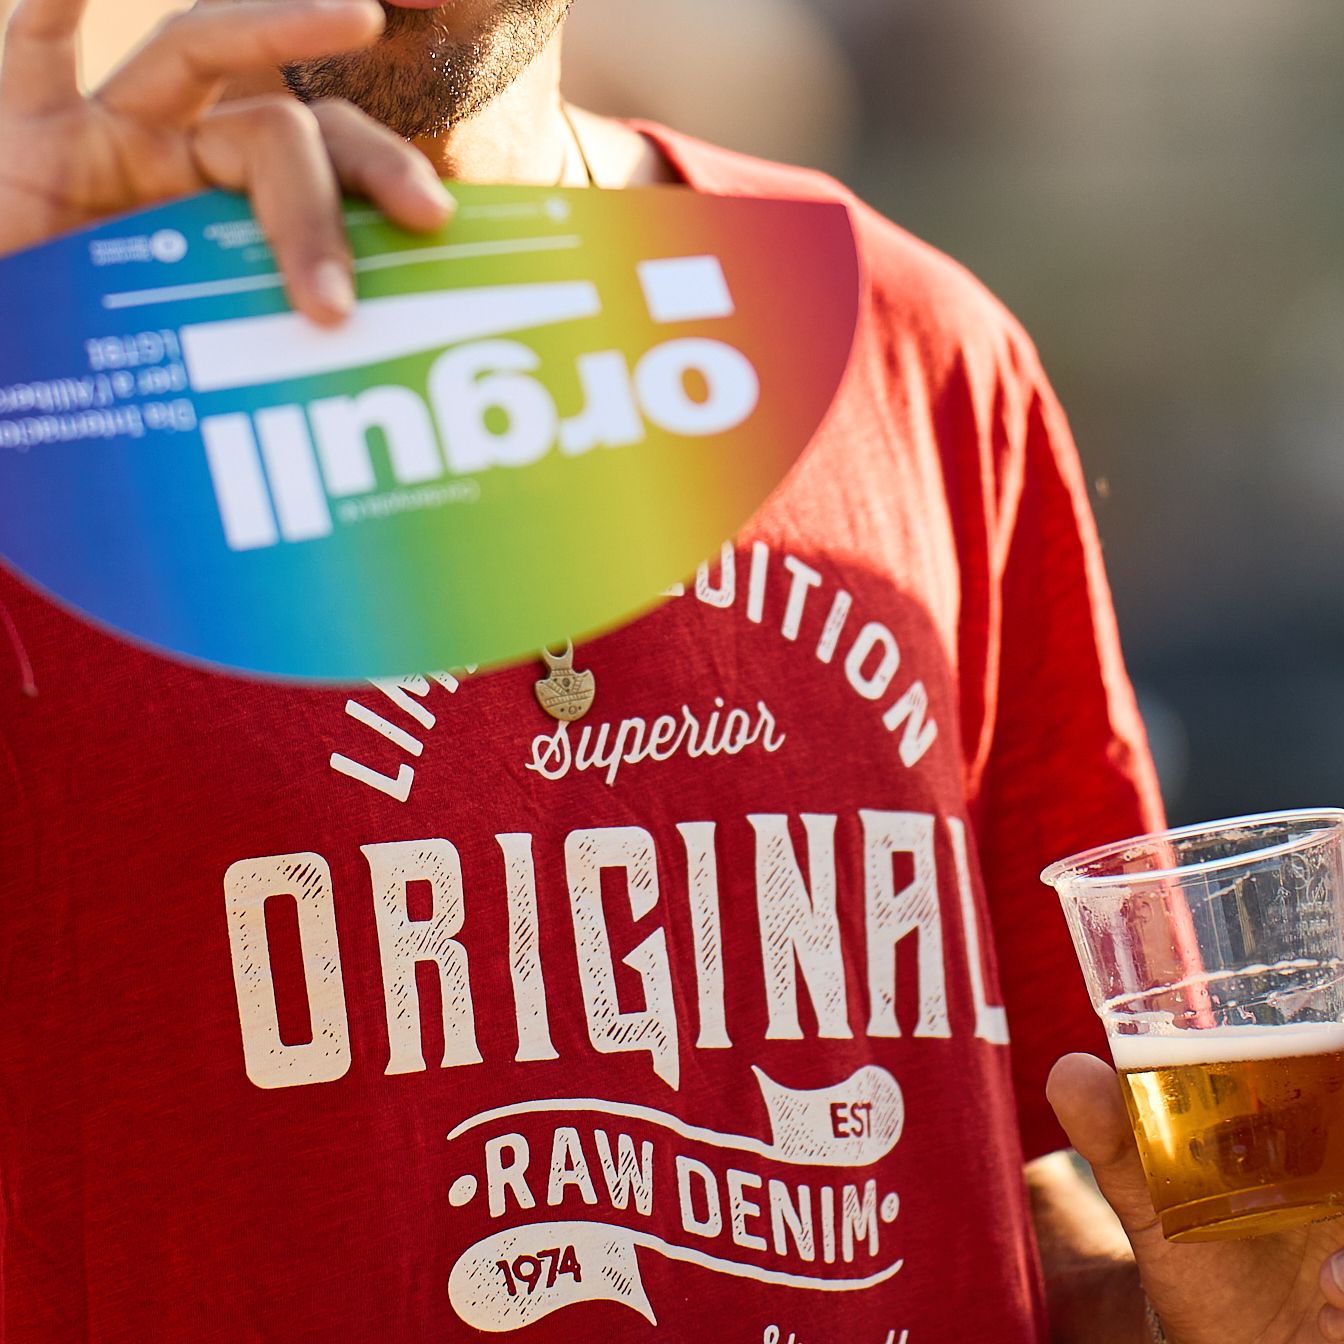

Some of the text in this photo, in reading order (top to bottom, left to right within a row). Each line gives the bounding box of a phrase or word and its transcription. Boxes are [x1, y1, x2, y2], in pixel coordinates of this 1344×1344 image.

[201, 337, 760, 552] orgull
[658, 540, 938, 768] DITION
[524, 696, 786, 787] Superior
[223, 809, 1011, 1092] ORIGINAL
[829, 1101, 873, 1140] EST
[484, 1127, 880, 1264] RAW DENIM
[496, 1244, 582, 1297] 1974
